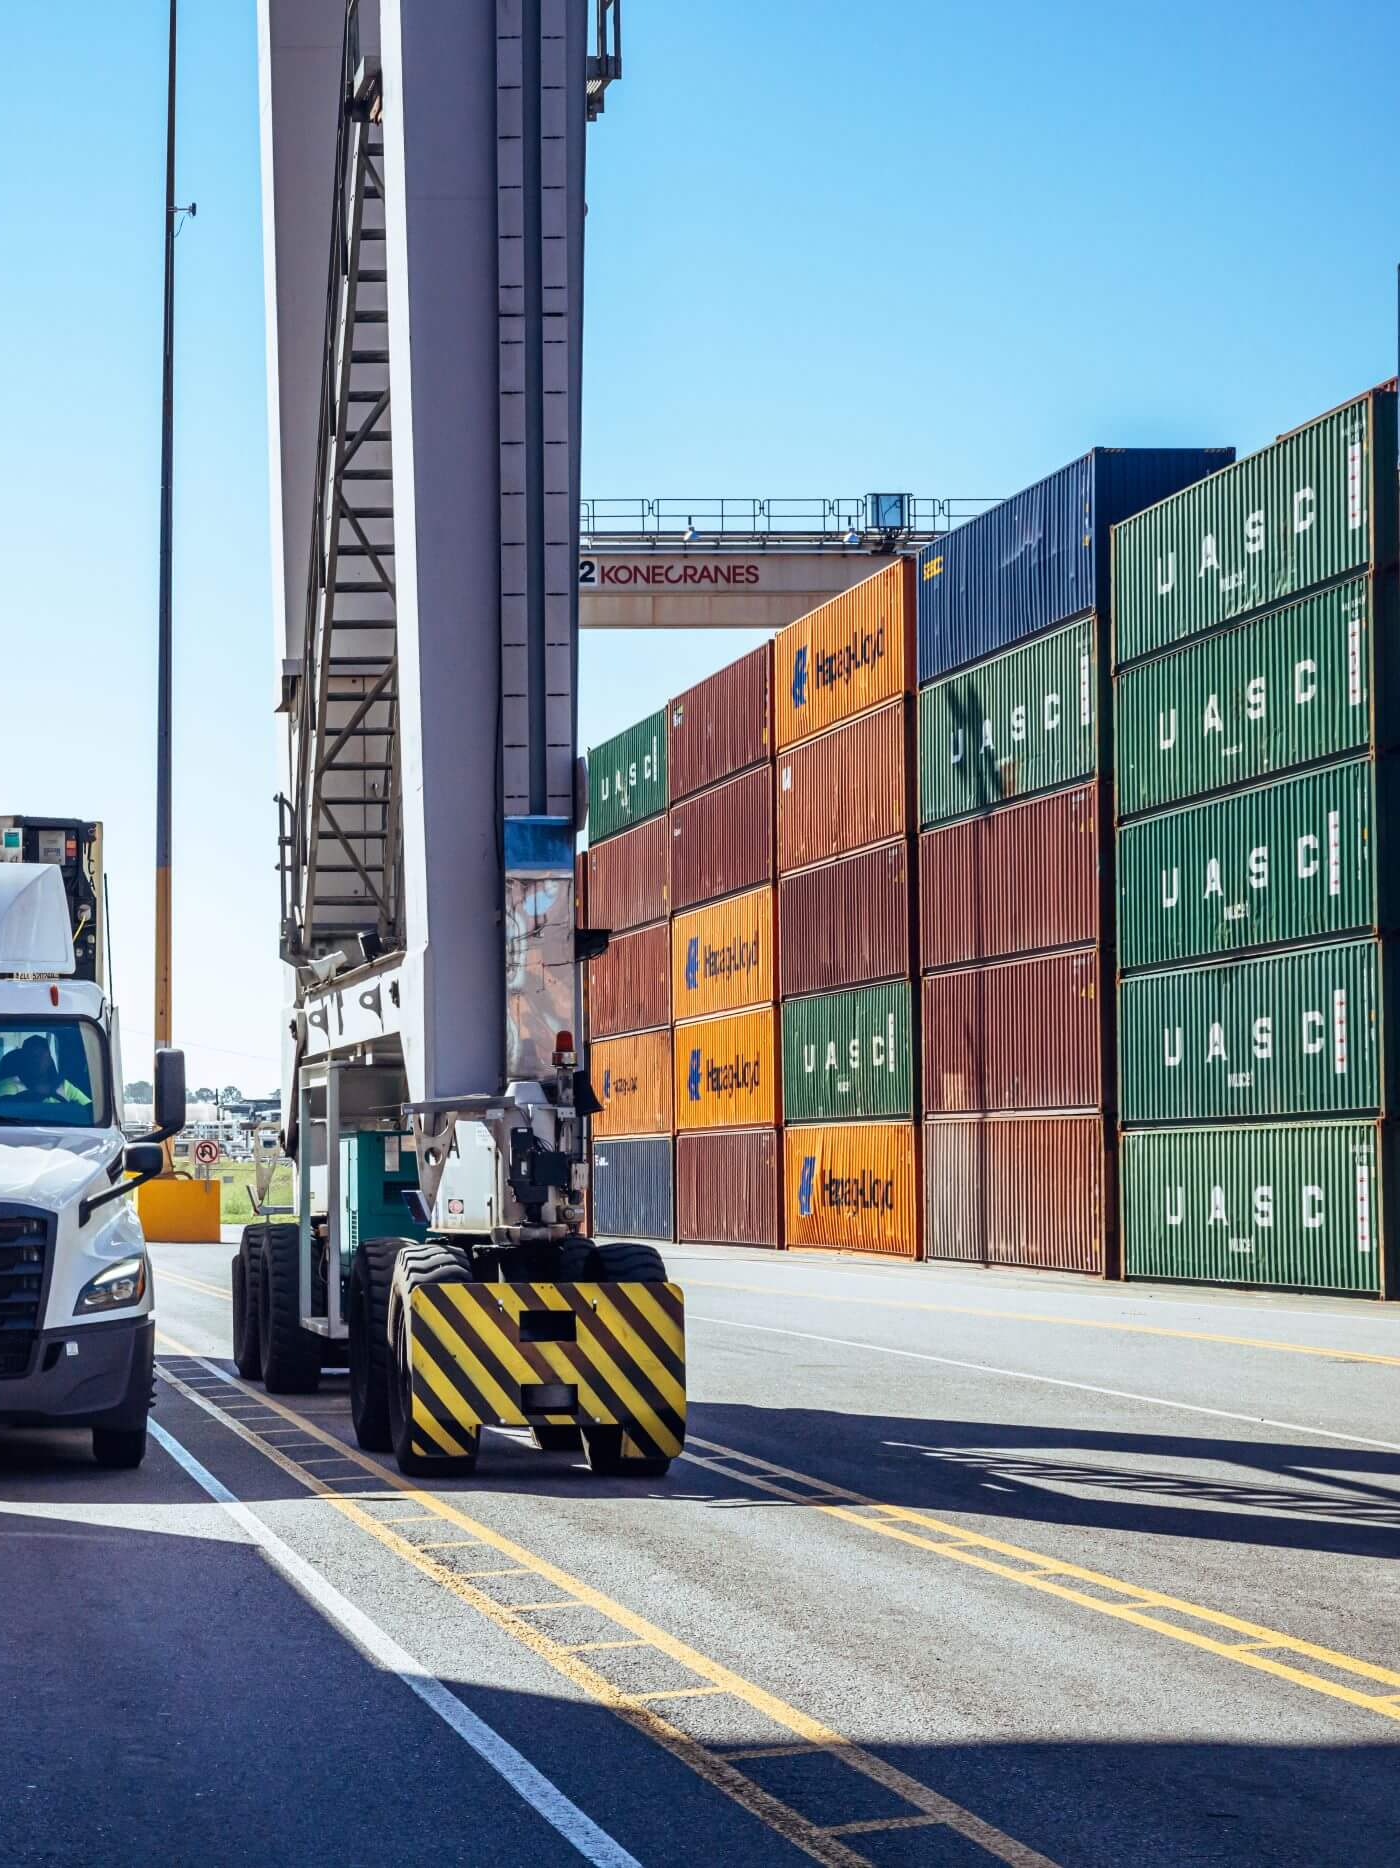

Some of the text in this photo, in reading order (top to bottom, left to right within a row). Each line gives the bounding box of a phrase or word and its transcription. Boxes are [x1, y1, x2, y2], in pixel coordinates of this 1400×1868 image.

[600, 565, 760, 584] KONECRANES
[950, 693, 1061, 764] UASC
[1158, 659, 1317, 750] UASC
[1160, 834, 1319, 908] UASC
[803, 1035, 885, 1073] UASC
[1163, 1011, 1324, 1066] UASC
[1165, 1185, 1324, 1228] UASC
